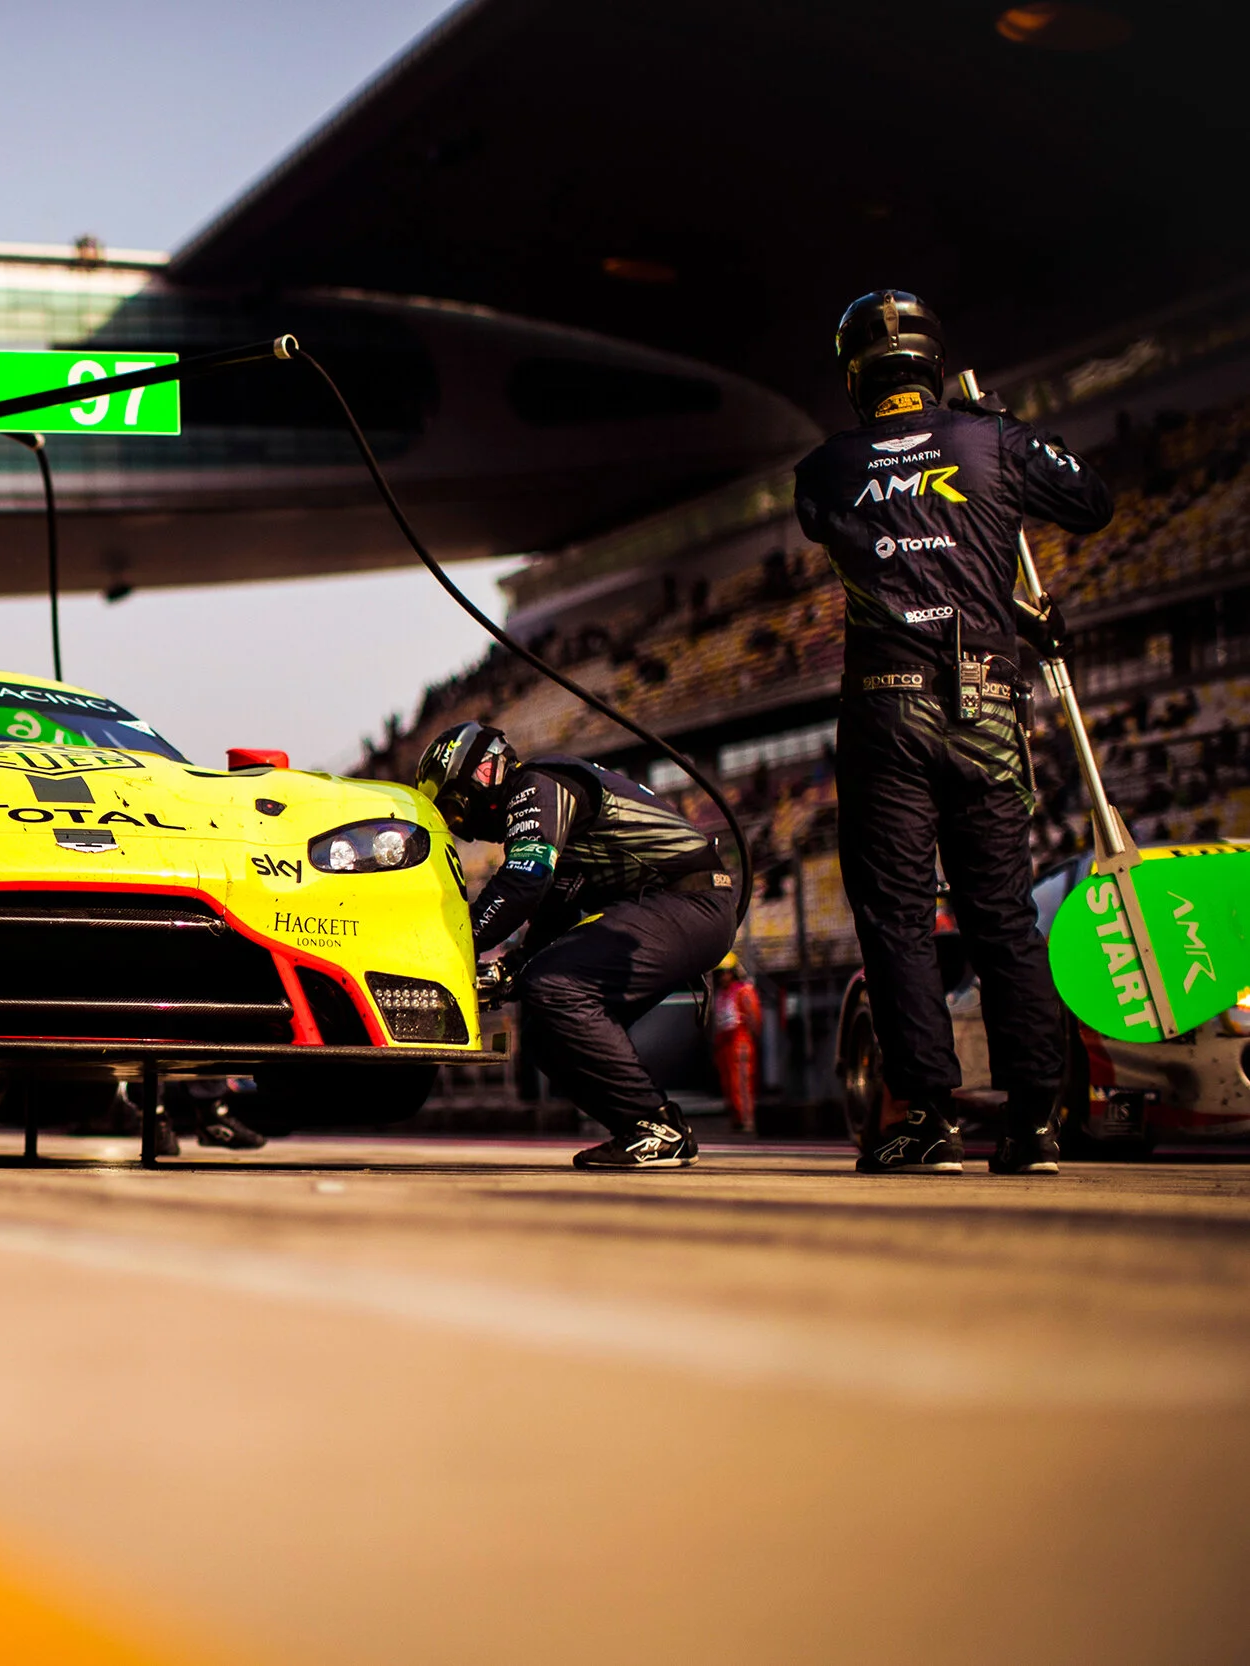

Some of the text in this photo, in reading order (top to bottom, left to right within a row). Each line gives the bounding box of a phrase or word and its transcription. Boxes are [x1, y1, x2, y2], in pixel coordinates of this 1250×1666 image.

[67, 359, 156, 426] 97
[867, 449, 941, 470] ASTON MARTIN
[854, 465, 968, 507] AMR
[897, 536, 956, 552] TOTAL
[905, 606, 953, 623] sparco
[863, 673, 924, 690] sparco
[514, 807, 541, 819] TOTAL
[251, 854, 302, 884] sky
[274, 912, 359, 936] HACKETT
[297, 938, 341, 947] LONDON
[1167, 891, 1217, 994] AMR
[1086, 882, 1158, 1028] START
